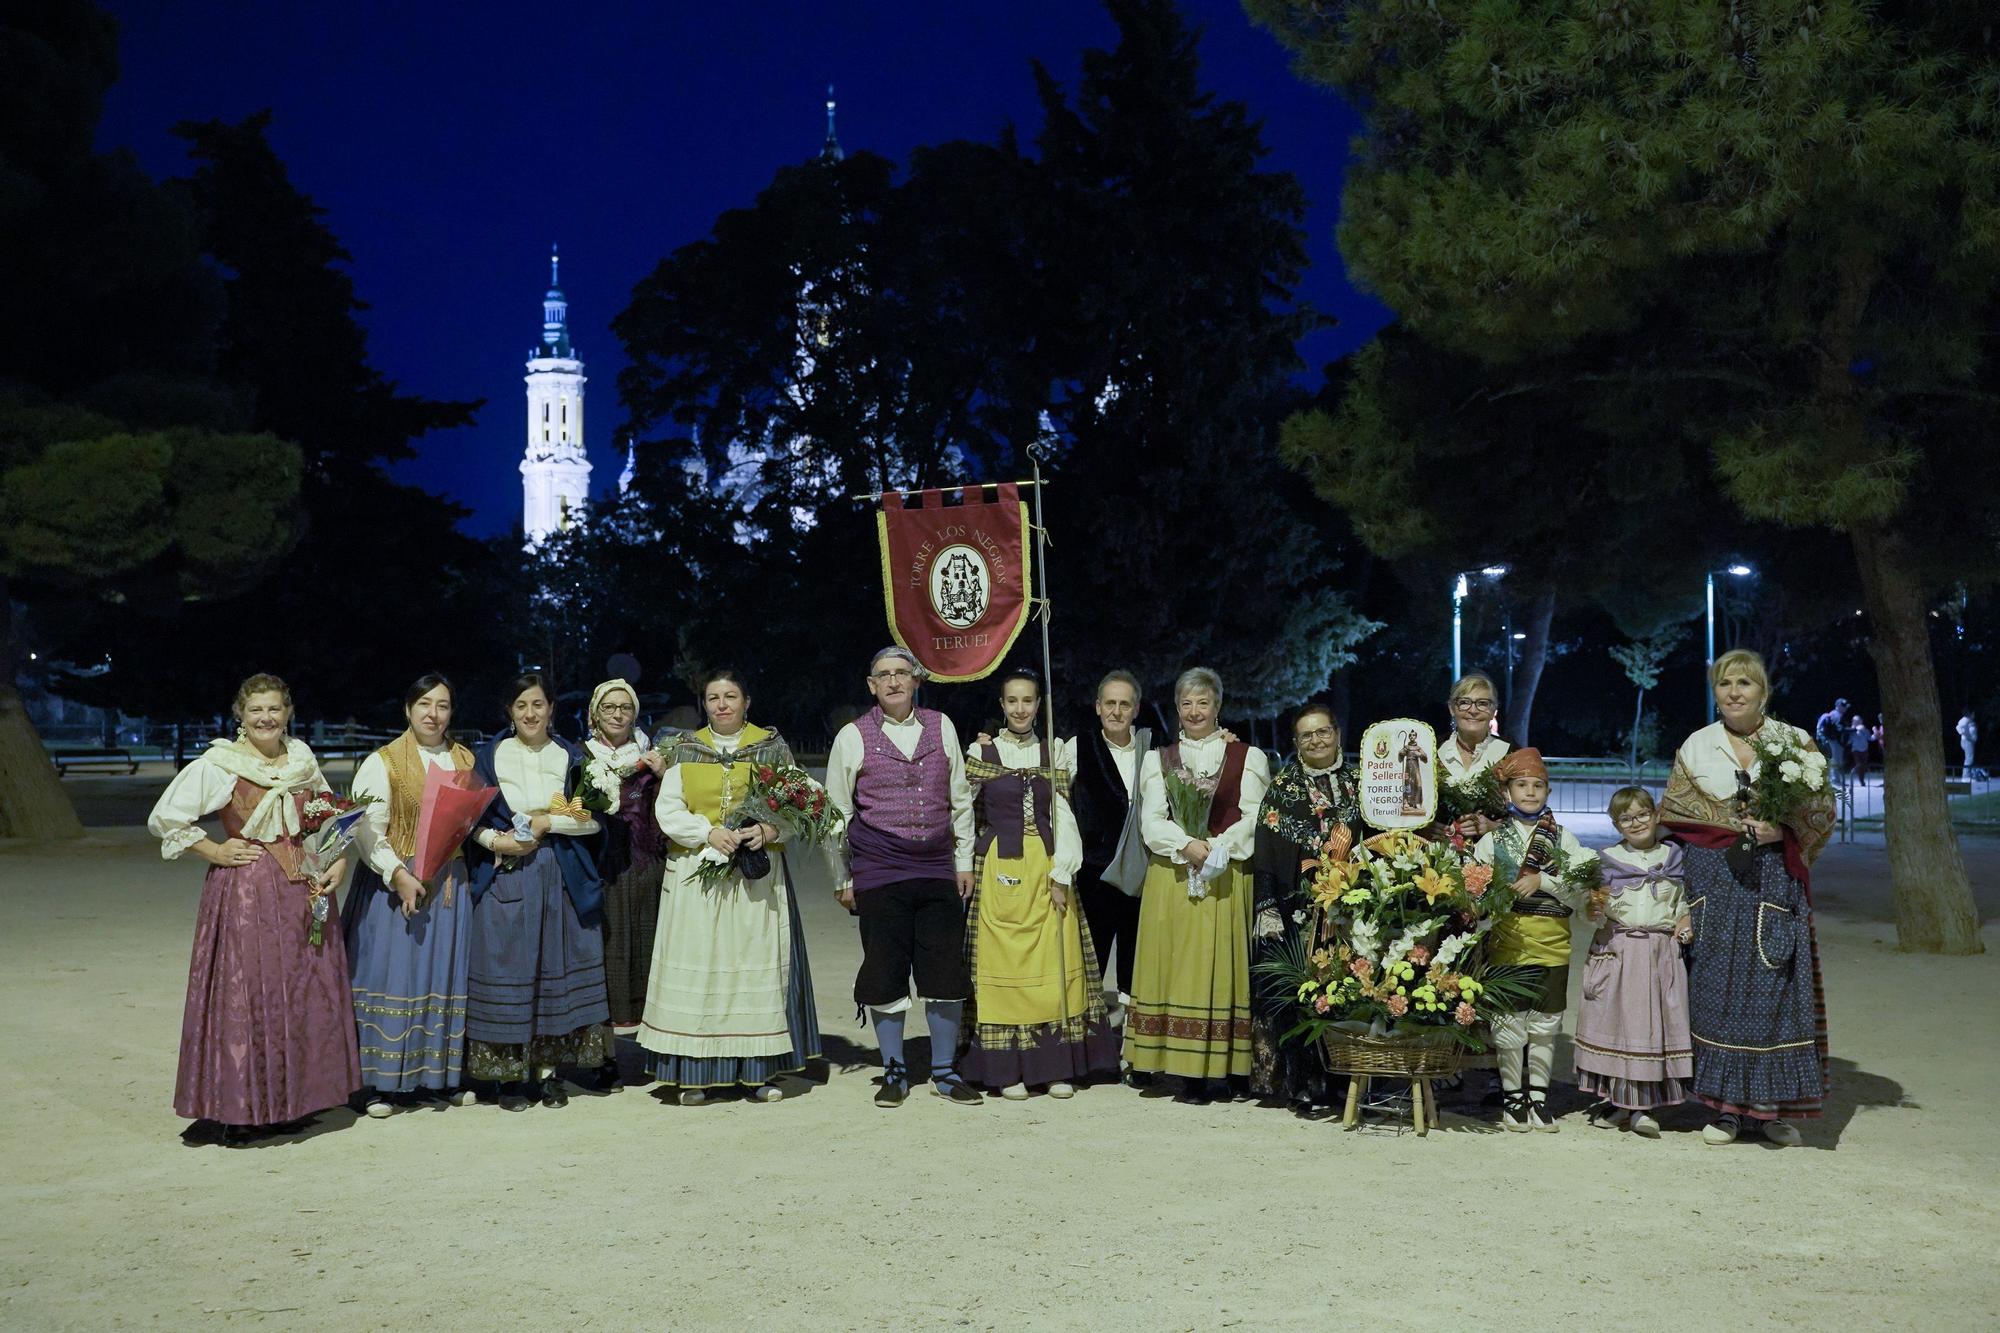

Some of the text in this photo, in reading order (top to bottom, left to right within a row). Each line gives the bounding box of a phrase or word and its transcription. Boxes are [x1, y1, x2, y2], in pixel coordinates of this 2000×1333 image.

[910, 526, 1007, 589] TORRE LOS NEGROS
[932, 634, 992, 650] TERUEL
[1367, 761, 1393, 770] Padre
[1372, 771, 1409, 780] Selleras
[1367, 785, 1392, 793] TORRE
[1370, 796, 1402, 804] NEGROS
[1372, 808, 1400, 816] (Teruel)
